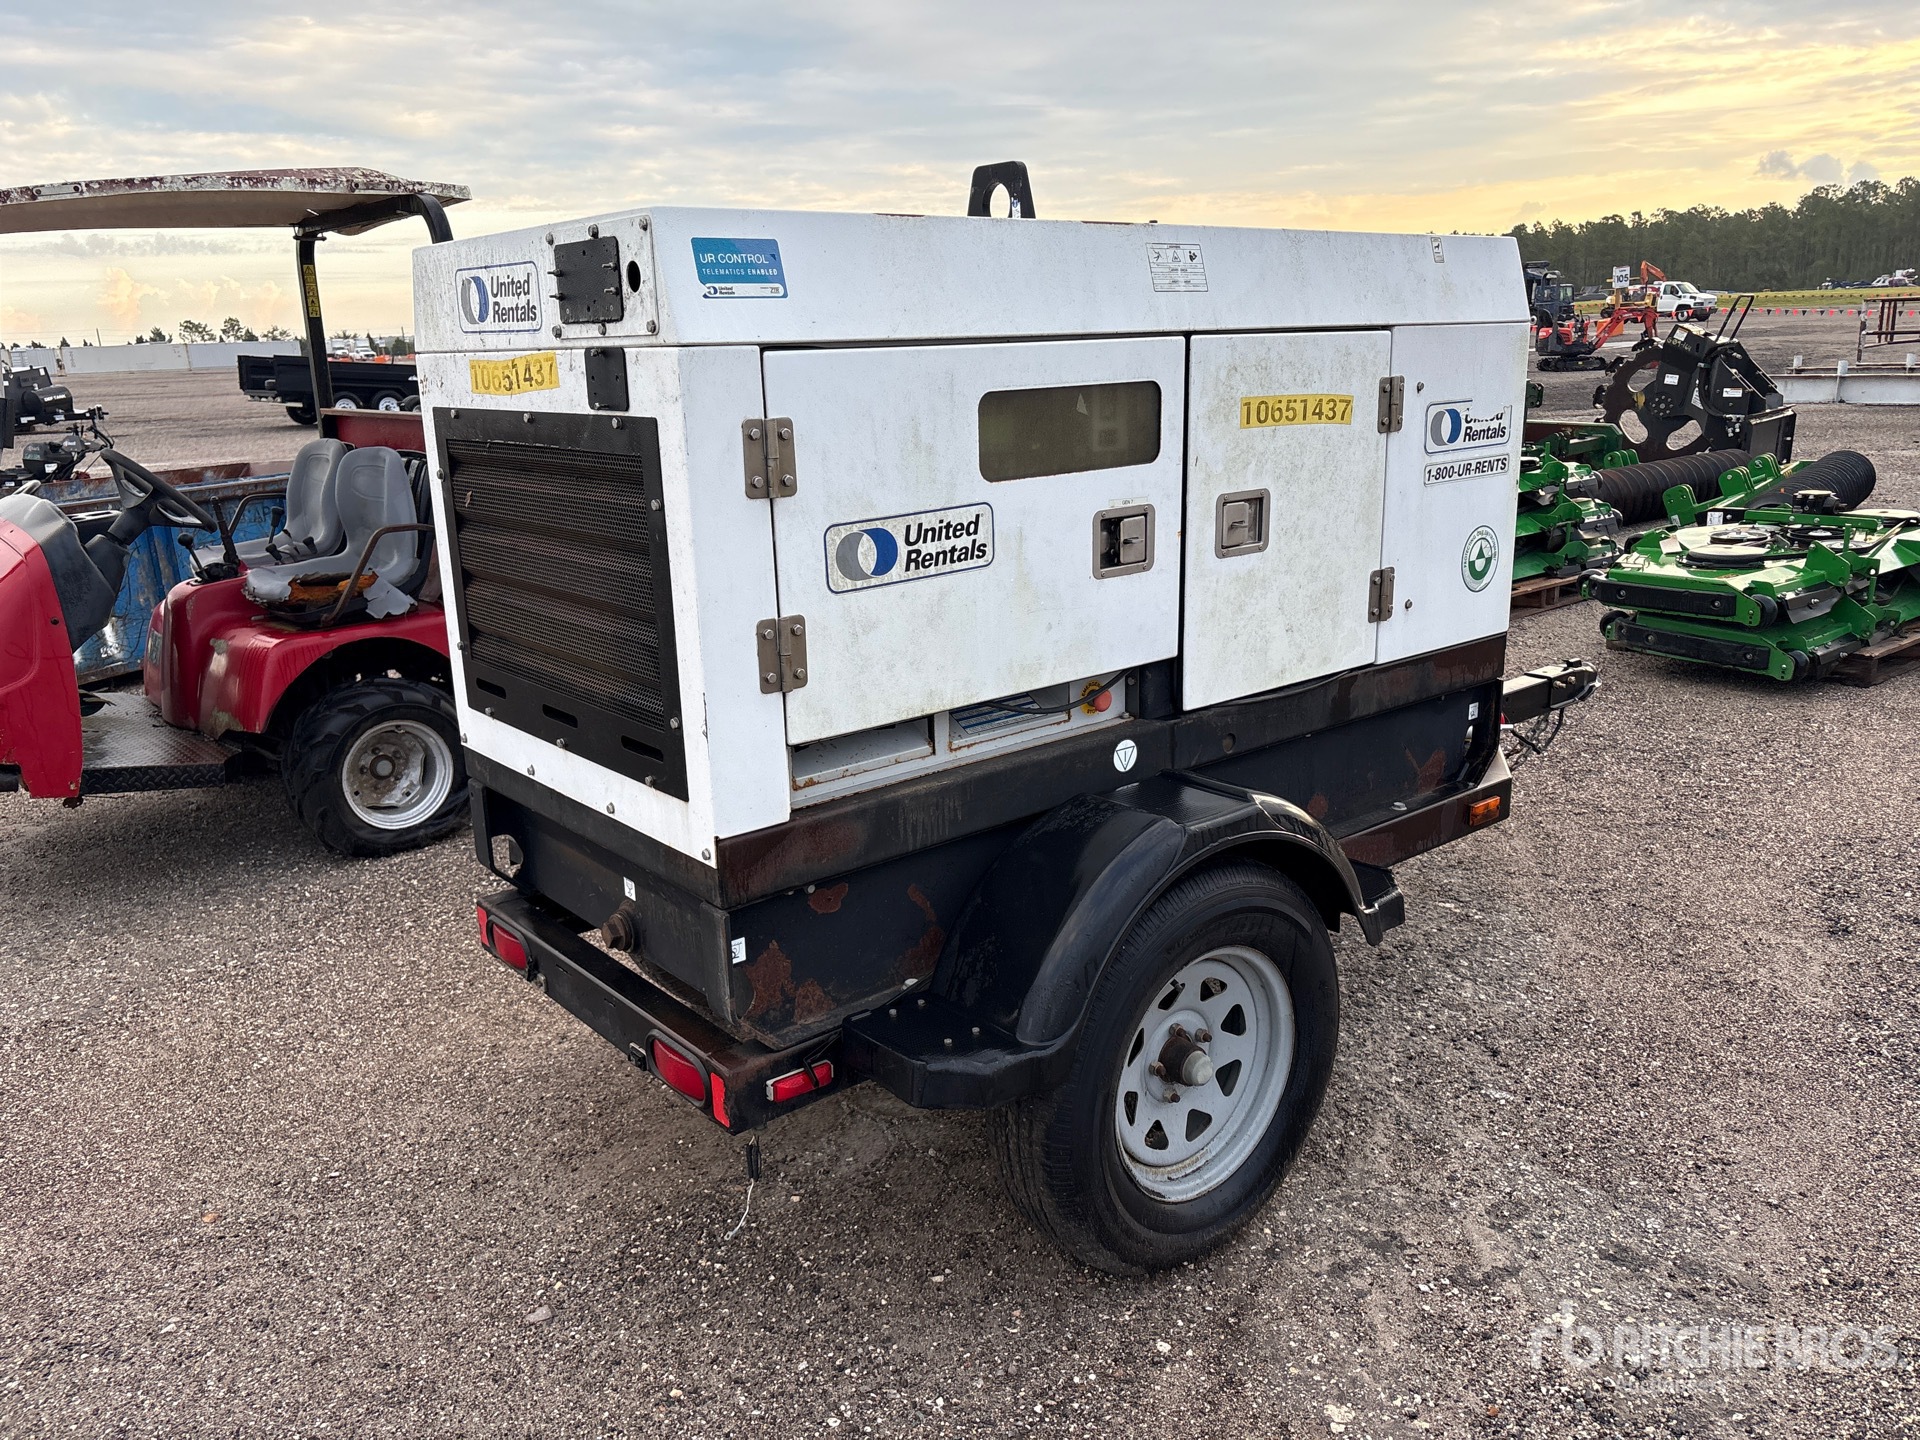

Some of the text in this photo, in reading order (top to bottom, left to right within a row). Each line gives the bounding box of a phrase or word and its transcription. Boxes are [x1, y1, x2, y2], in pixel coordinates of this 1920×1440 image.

[700, 253, 769, 264] UR CONTROL
[747, 268, 778, 276] ENABLED
[1616, 274, 1629, 283] 105
[490, 272, 531, 298] United
[492, 299, 537, 323] Rentals
[471, 357, 555, 392] 10651437
[1243, 398, 1352, 424] 10651437
[1463, 422, 1507, 443] Rentals
[1426, 457, 1508, 482] 1-800-UR-RENTS
[904, 513, 981, 547] United
[904, 539, 988, 573] Rentals
